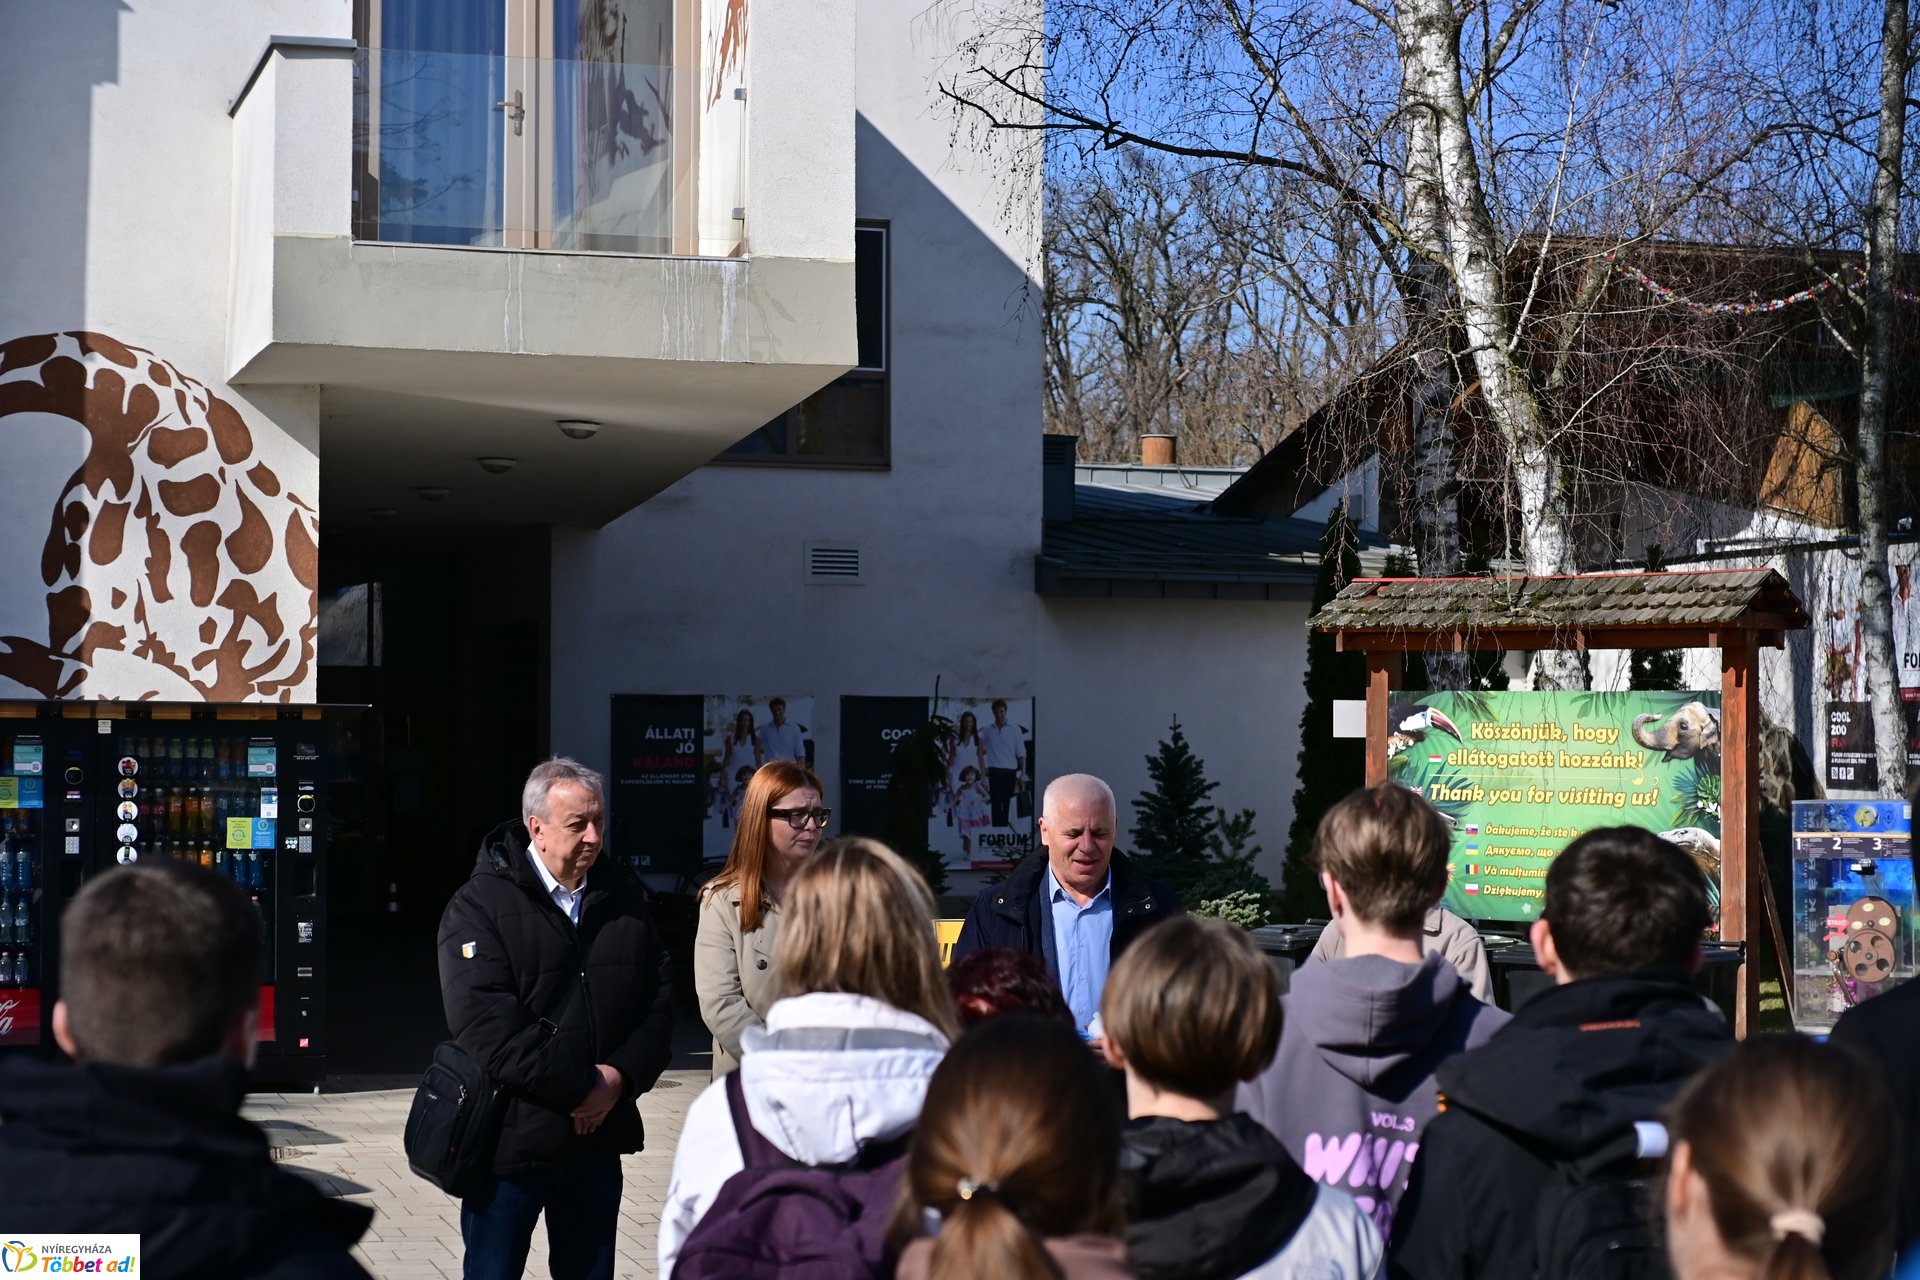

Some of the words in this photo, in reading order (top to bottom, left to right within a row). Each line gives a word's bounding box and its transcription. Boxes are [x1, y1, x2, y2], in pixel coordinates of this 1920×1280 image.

[1903, 652, 1920, 669] FO
[1830, 711, 1851, 723] COOL
[645, 724, 695, 740] ÁLLATI
[881, 728, 917, 740] COO
[1470, 722, 1568, 744] Köszönjük,
[1572, 723, 1620, 745] hogy
[1830, 724, 1847, 736] ZOO
[675, 739, 695, 754] JÓ
[632, 756, 695, 769] KALAND
[1447, 750, 1554, 768] ellátogatott
[1558, 750, 1644, 770] hozzánk!
[1429, 783, 1485, 802] Thank
[1488, 788, 1522, 806] you
[1526, 785, 1553, 804] for
[1558, 787, 1626, 808] visiting
[1631, 788, 1659, 807] us!
[1485, 823, 1537, 837] Ďakujeme,
[1540, 825, 1552, 836] že
[1554, 827, 1568, 837] ste
[978, 833, 1027, 846] FORUM
[1795, 838, 1801, 850] 1
[1832, 838, 1842, 850] 2
[1872, 838, 1882, 851] 3
[1485, 845, 1534, 858] Дякуємо,
[1536, 849, 1554, 858] що
[1483, 885, 1545, 898] Dziękujemy,
